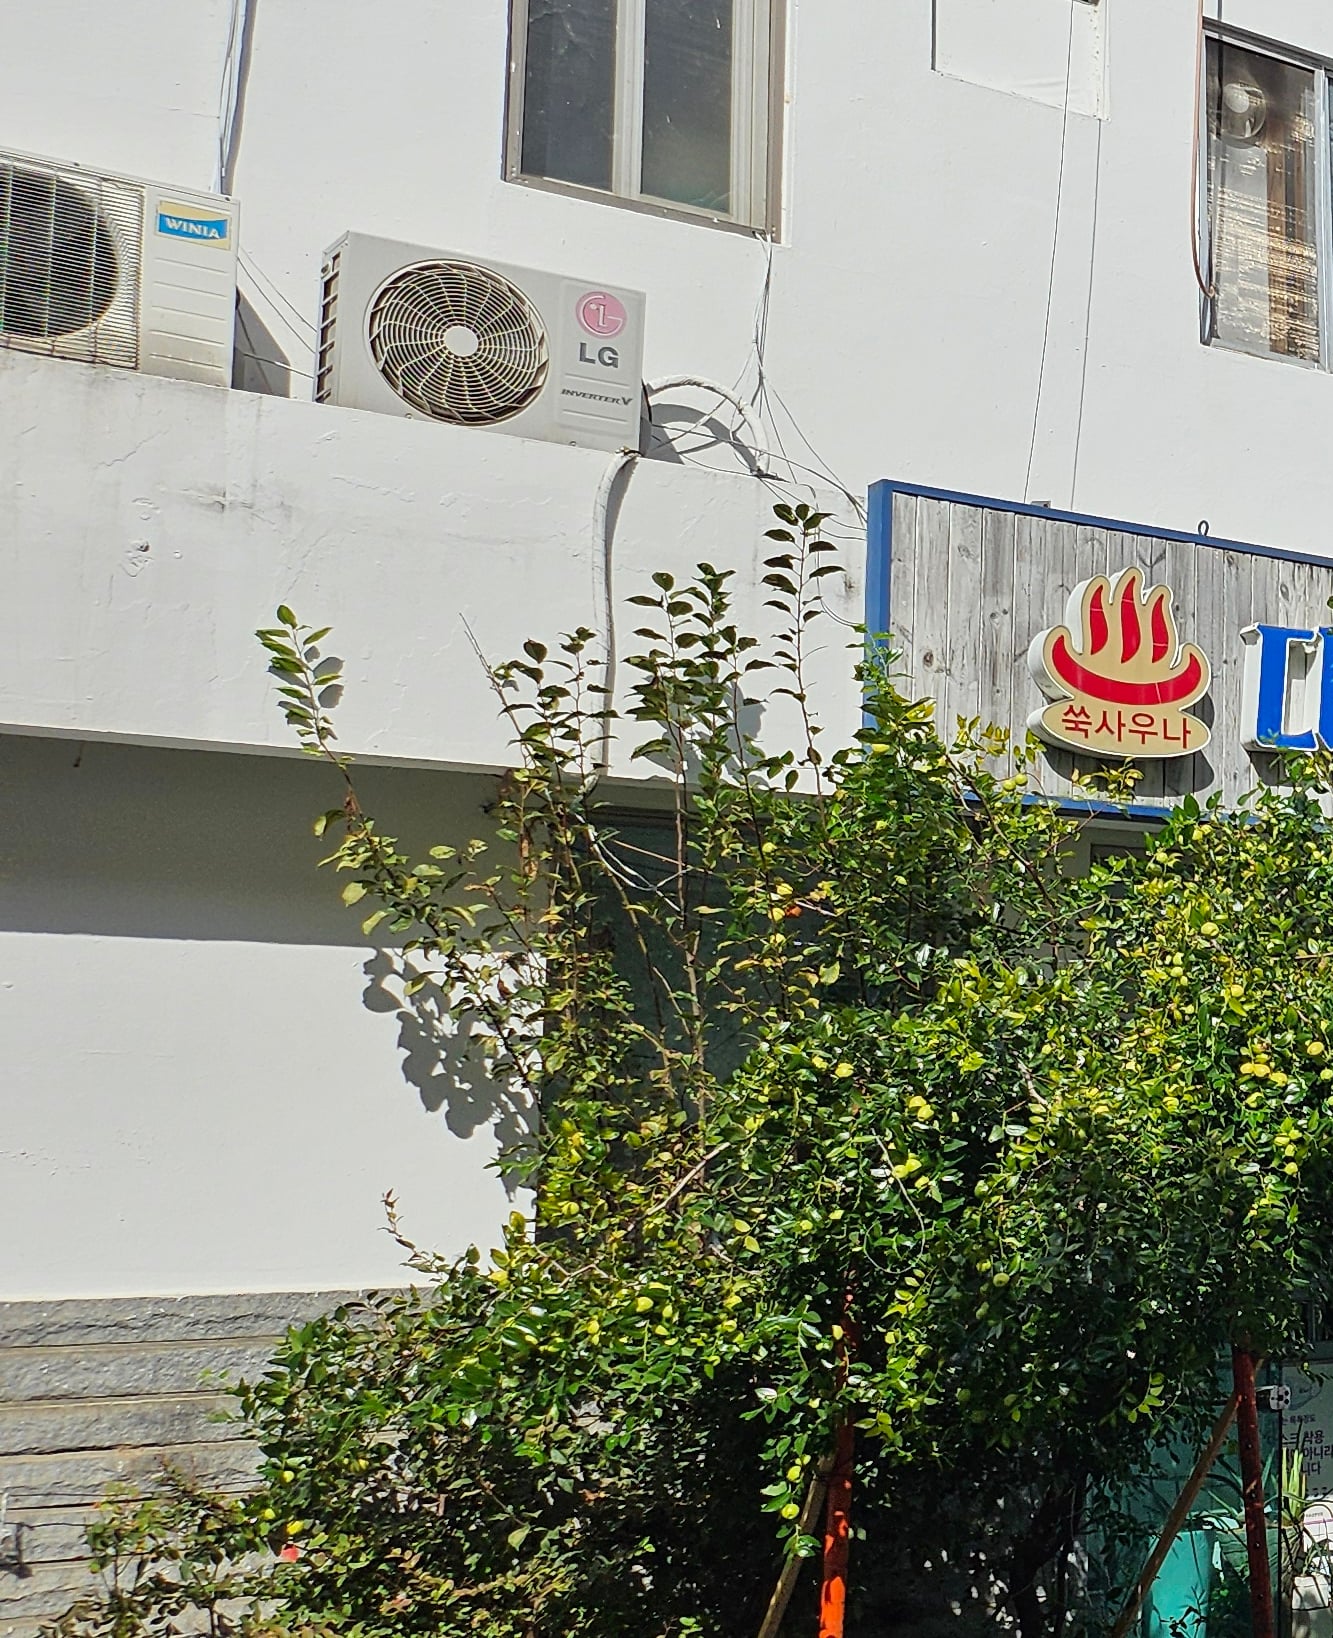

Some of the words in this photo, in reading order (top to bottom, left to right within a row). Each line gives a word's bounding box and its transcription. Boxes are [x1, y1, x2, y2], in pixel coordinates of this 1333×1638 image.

[165, 216, 221, 240] WINIA
[579, 342, 619, 368] LG
[1061, 704, 1192, 749] 쑥사우나
